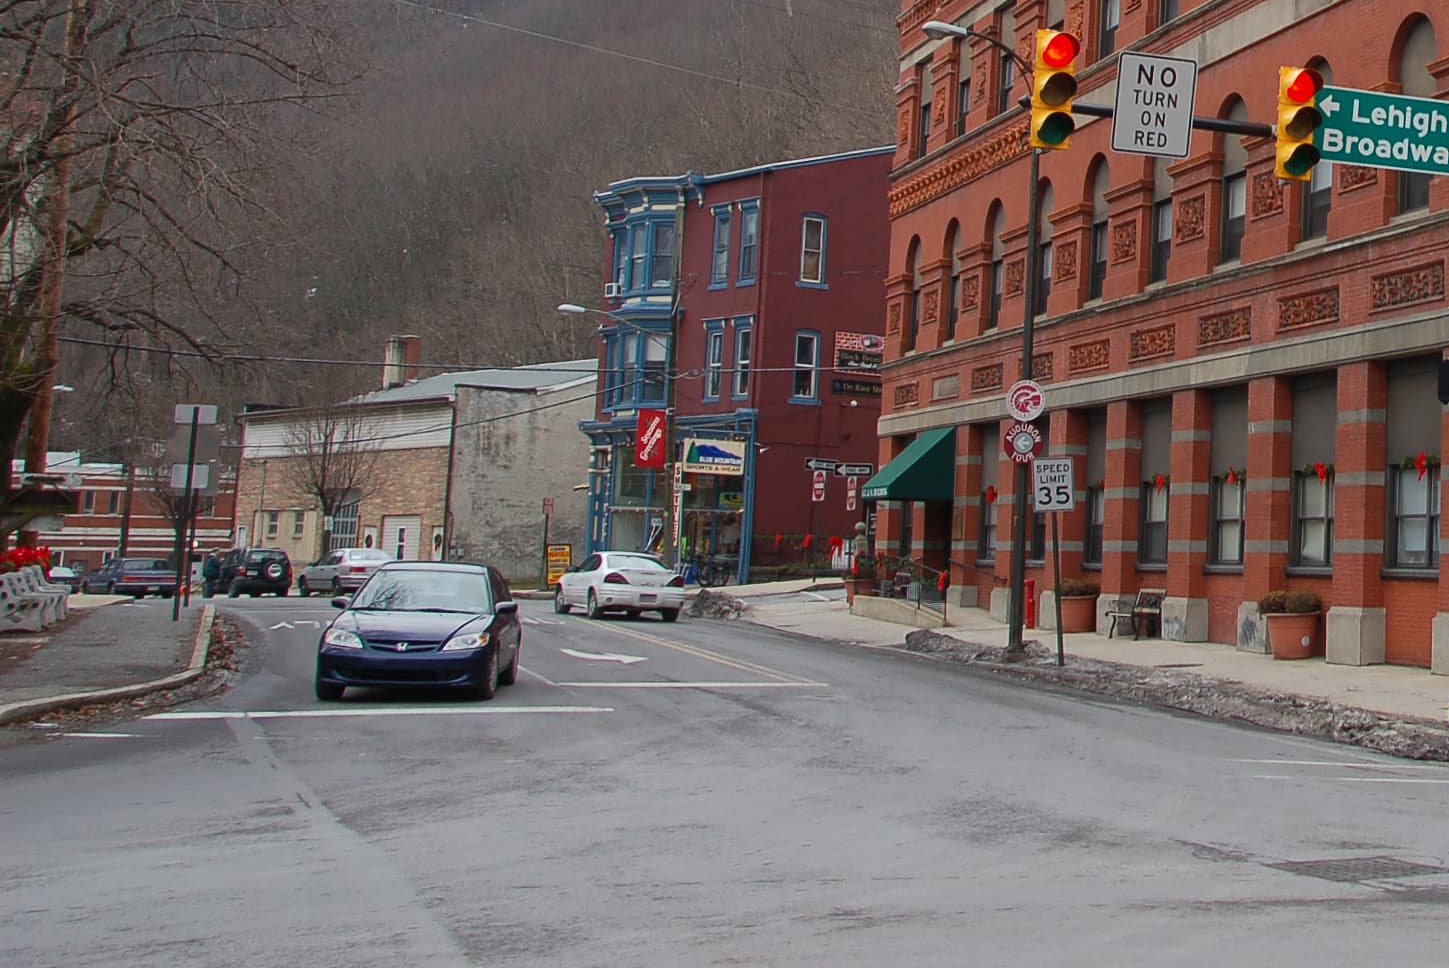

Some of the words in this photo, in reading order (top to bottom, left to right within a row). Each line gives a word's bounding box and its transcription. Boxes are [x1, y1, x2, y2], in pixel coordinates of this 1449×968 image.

[1137, 64, 1177, 88] NO
[1133, 89, 1178, 109] TURN
[1140, 110, 1166, 128] ON
[1352, 99, 1447, 138] Lehigh
[1134, 130, 1168, 148] RED
[1006, 423, 1041, 443] AUDUBON
[1011, 451, 1035, 463] TOUR
[1036, 464, 1070, 473] SPEED
[1040, 474, 1066, 484] LIMIT
[1039, 486, 1070, 505] 35
